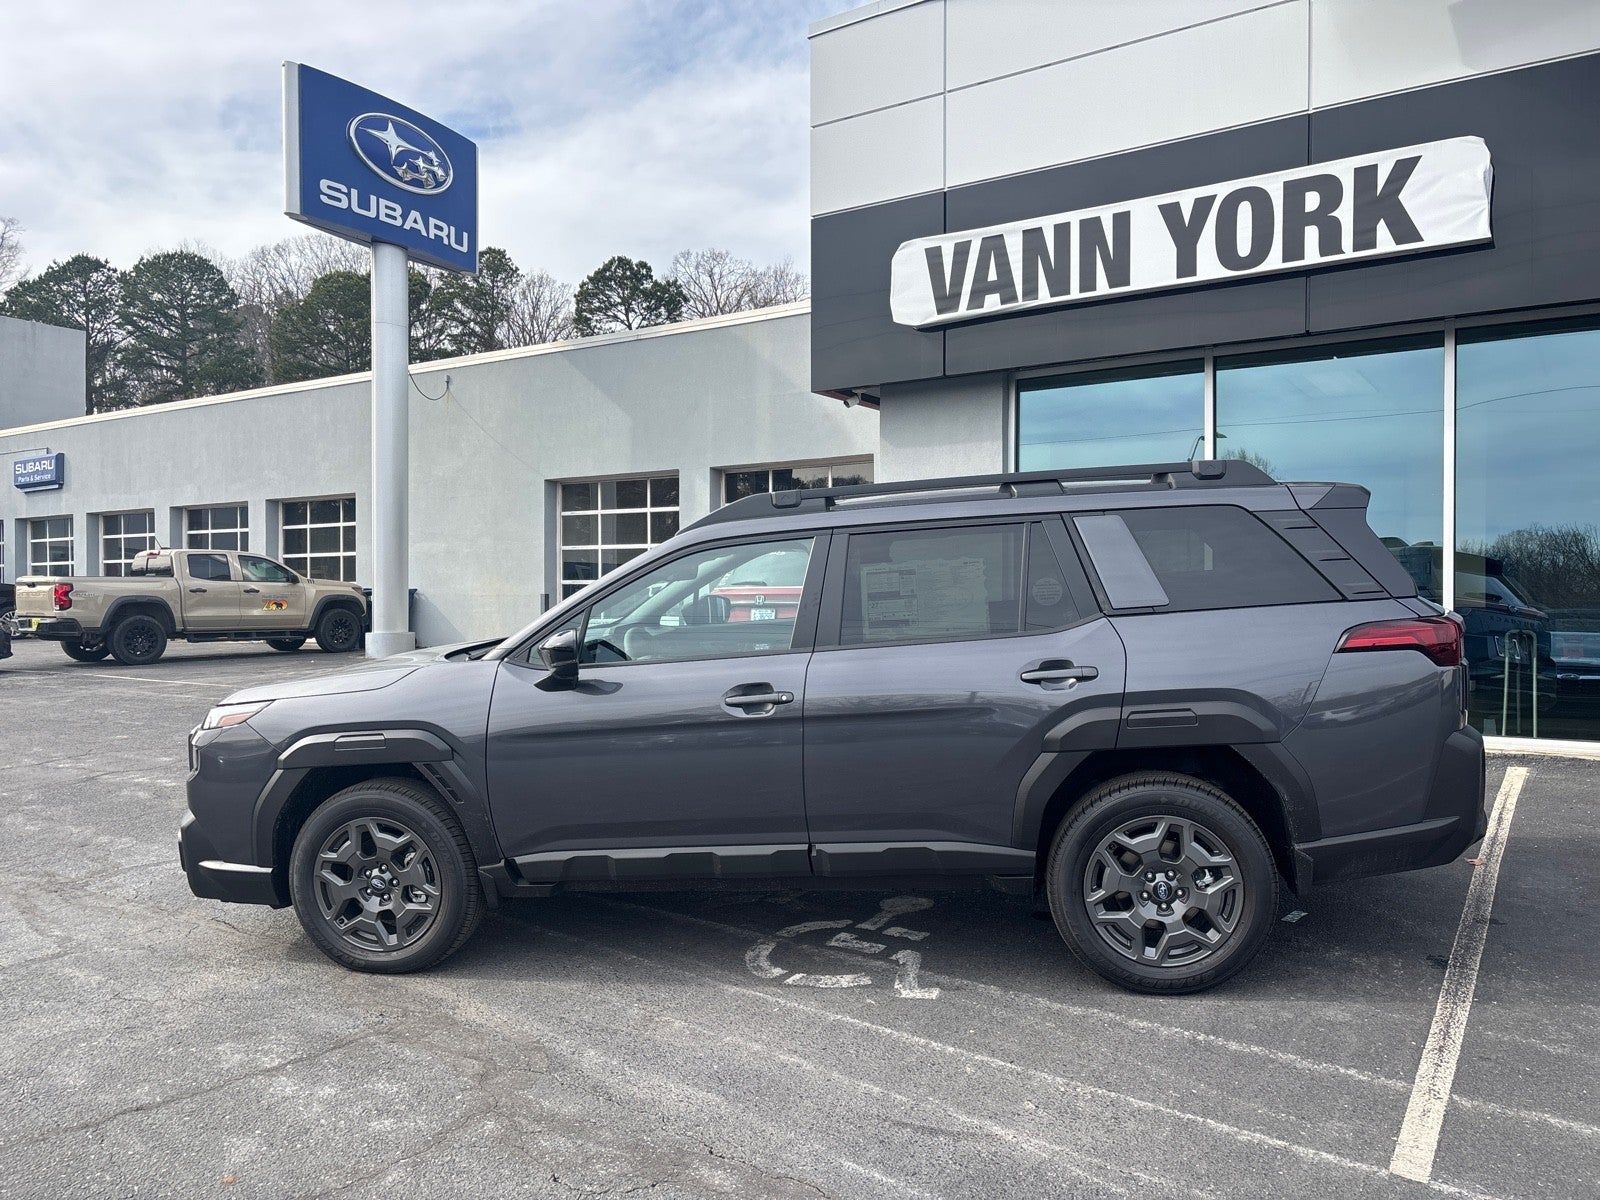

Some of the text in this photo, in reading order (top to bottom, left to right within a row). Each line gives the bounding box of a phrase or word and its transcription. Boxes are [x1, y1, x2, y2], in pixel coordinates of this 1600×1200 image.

[319, 178, 469, 253] SUBARU
[923, 154, 1425, 316] VANN YORK
[16, 460, 54, 474] SUBARU
